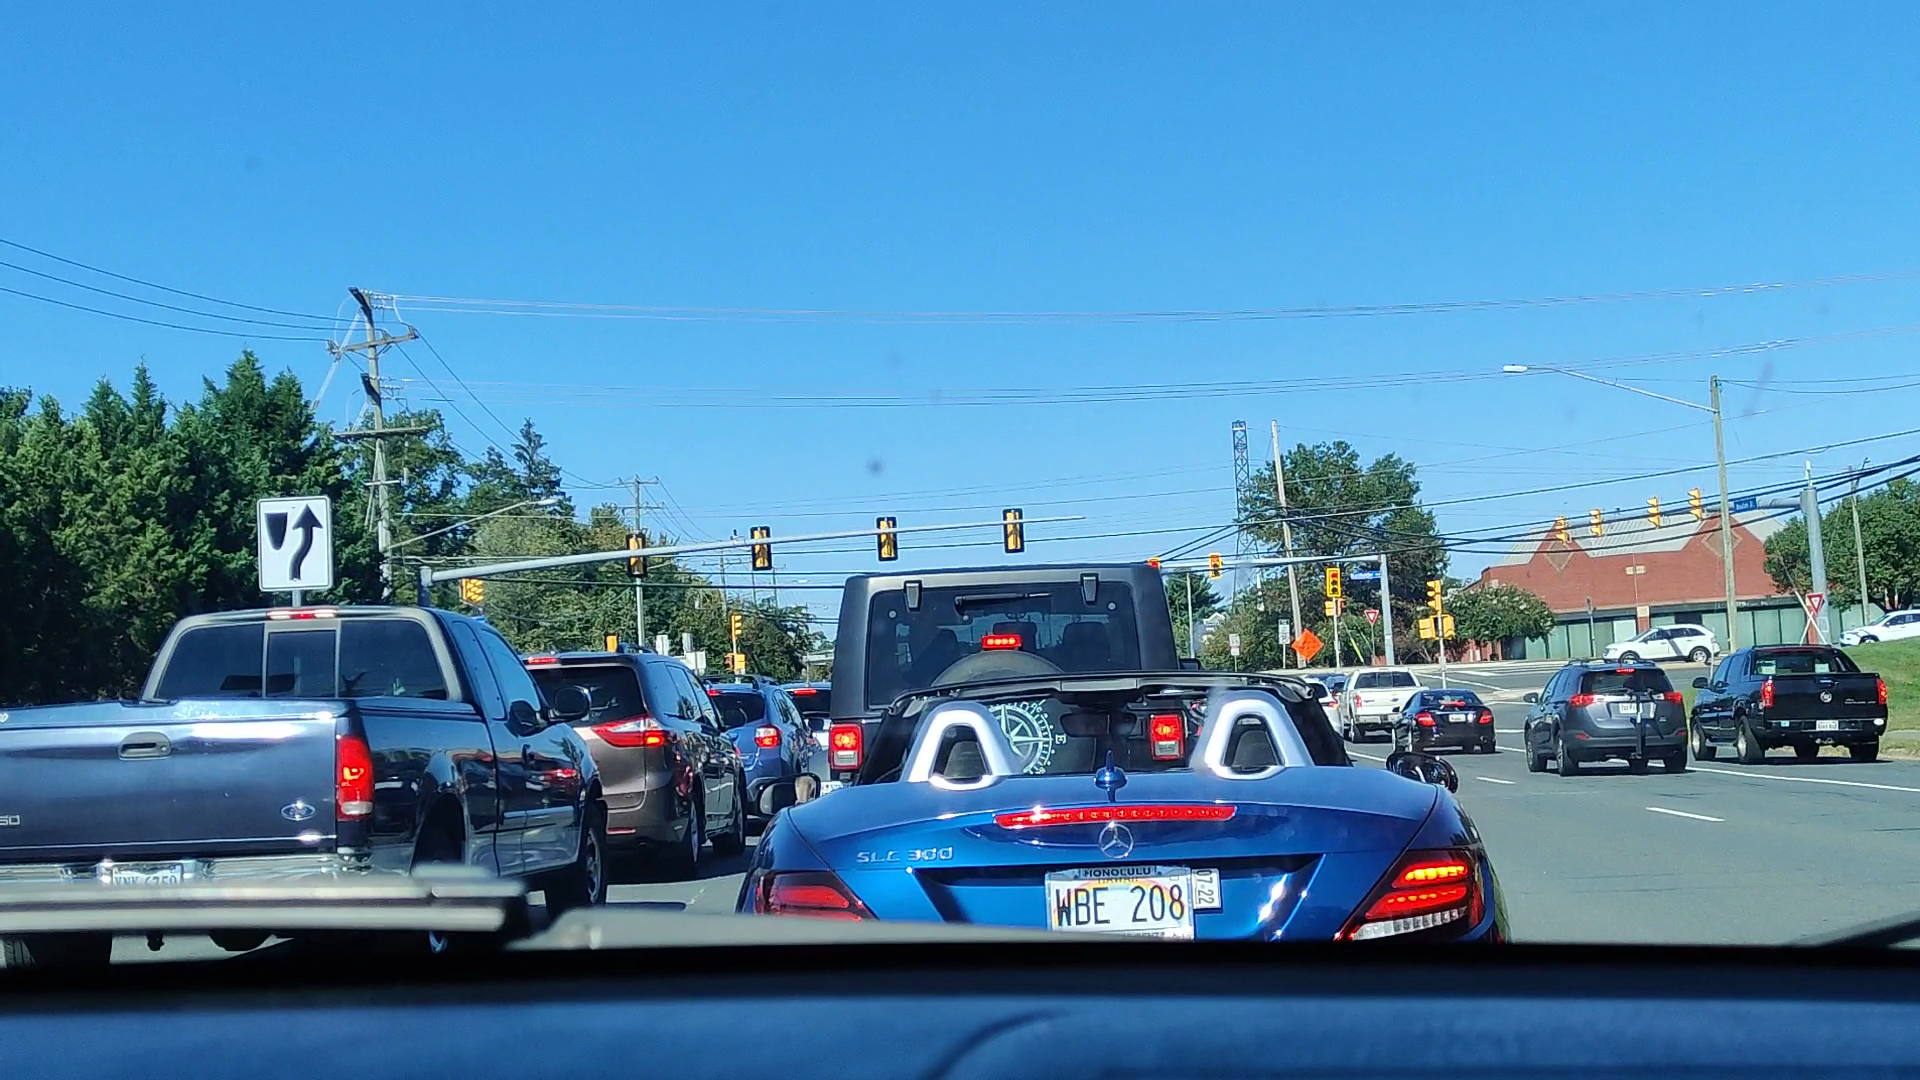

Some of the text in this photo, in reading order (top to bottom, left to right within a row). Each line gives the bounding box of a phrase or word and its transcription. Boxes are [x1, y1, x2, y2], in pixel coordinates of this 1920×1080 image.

[856, 850, 901, 863] SLC
[1083, 866, 1152, 878] HONOLULU
[1055, 884, 1185, 927] WBE 208
